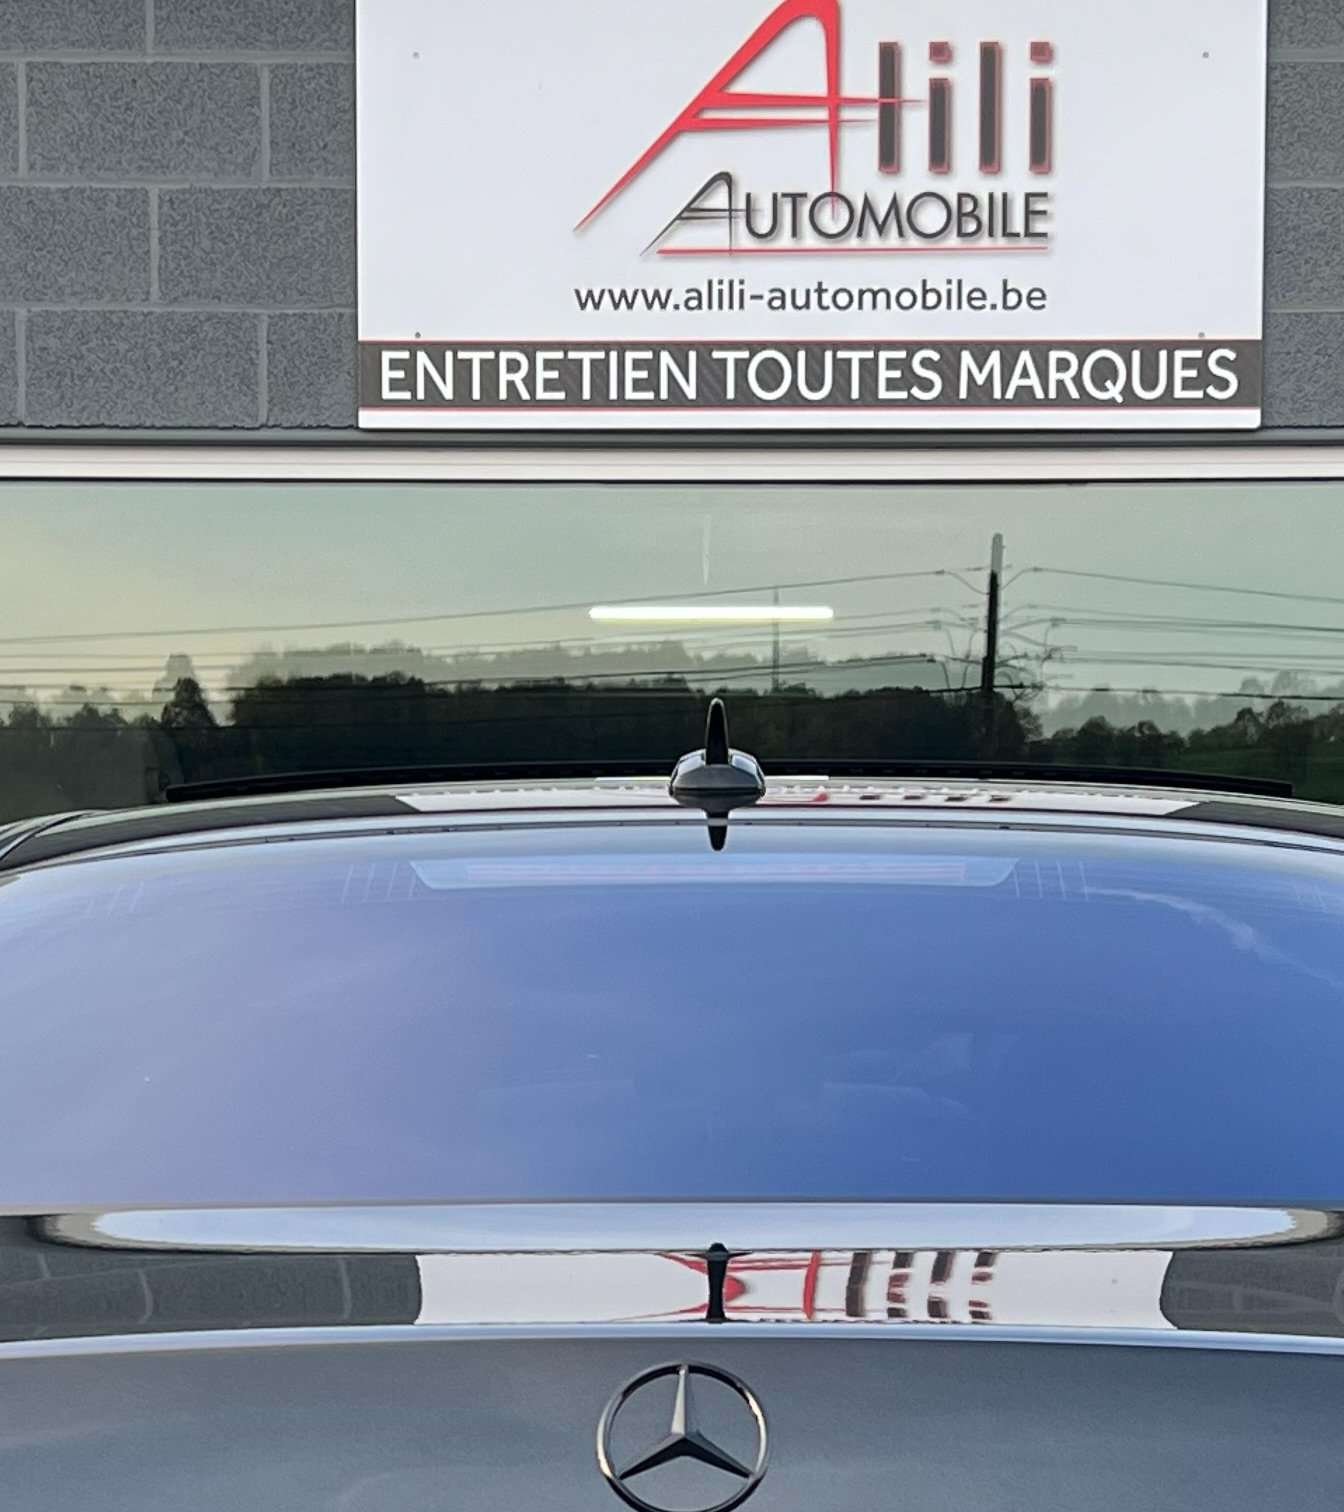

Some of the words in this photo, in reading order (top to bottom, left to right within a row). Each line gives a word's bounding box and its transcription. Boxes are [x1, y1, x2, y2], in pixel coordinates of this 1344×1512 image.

[573, 0, 1054, 231] Alili
[640, 171, 1049, 256] AUTOMOBILE
[574, 279, 1048, 312] www.alili-automobile.be
[380, 350, 697, 402] ENTRETIEN
[712, 349, 942, 400] TOUTES
[959, 348, 1239, 402] MARQUES
